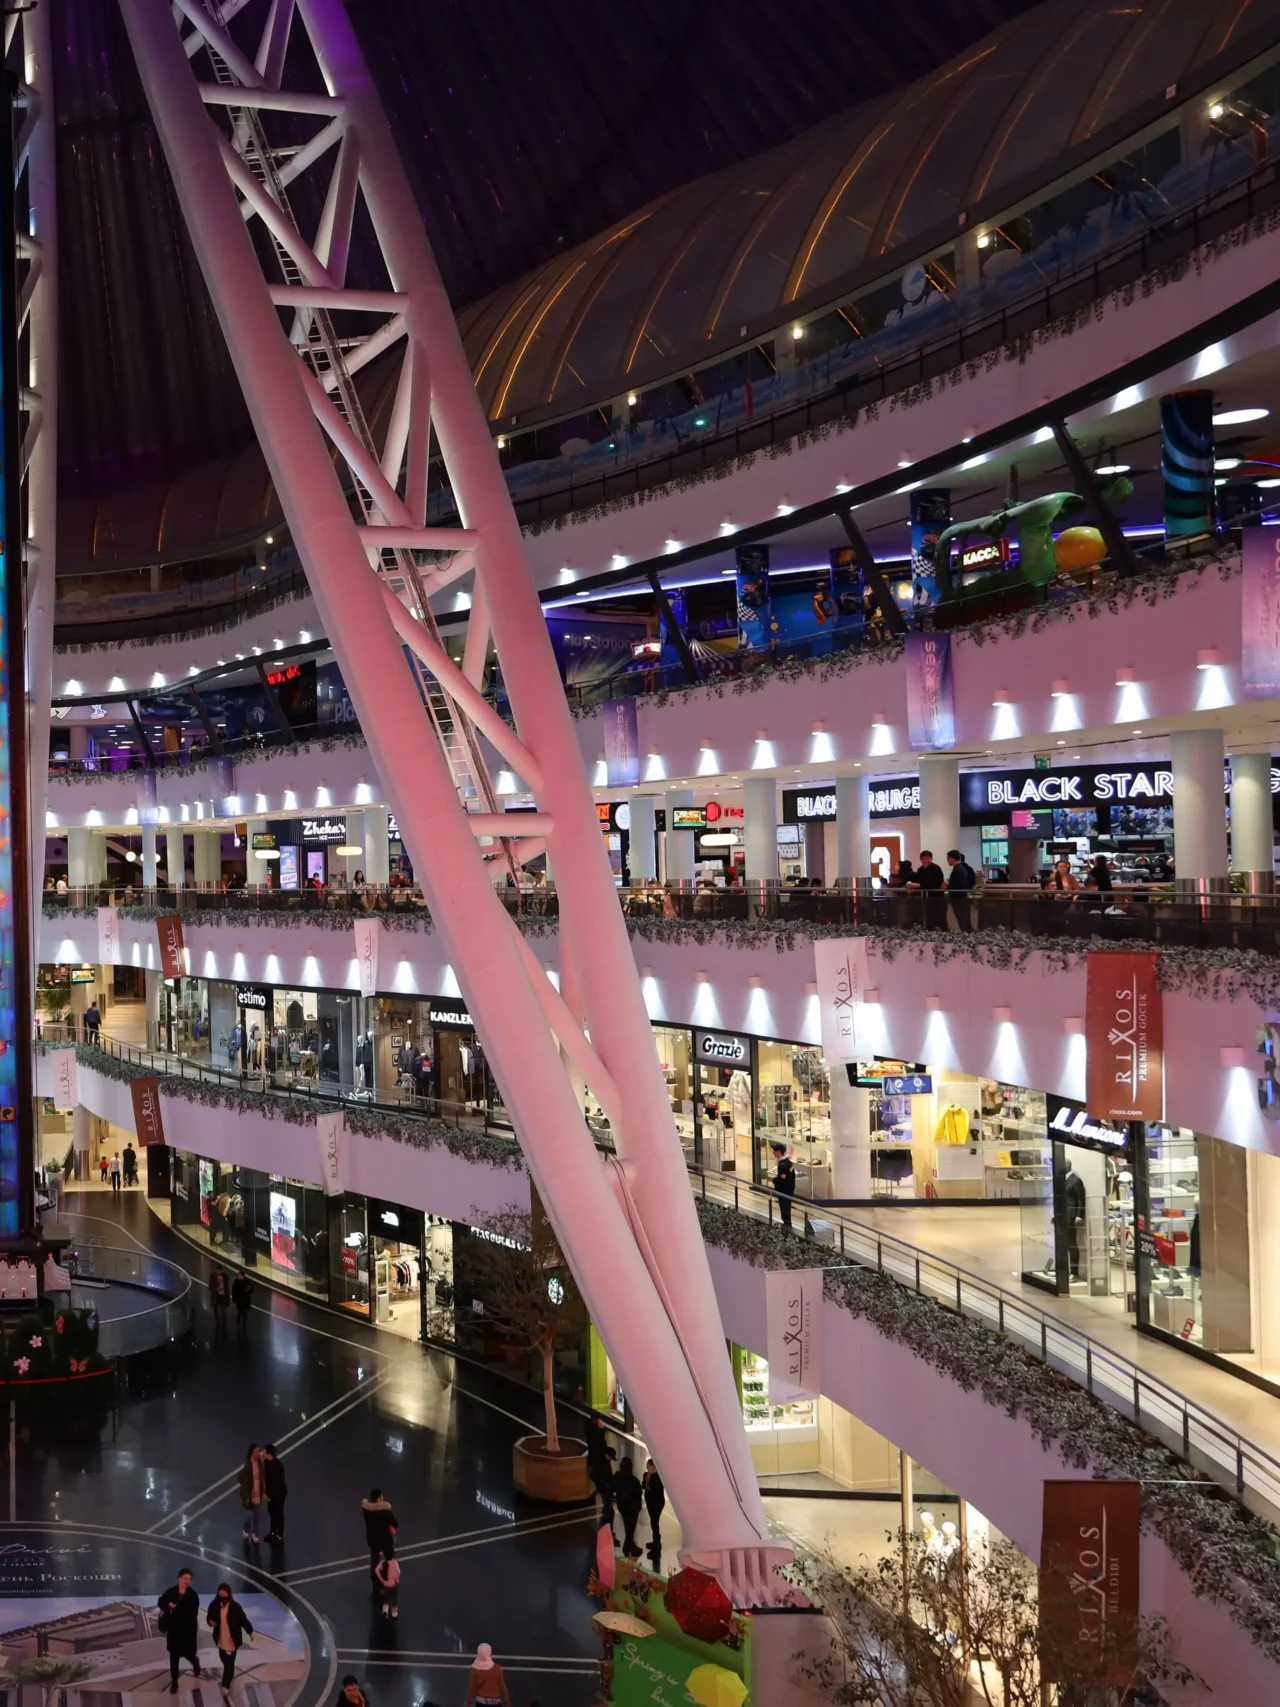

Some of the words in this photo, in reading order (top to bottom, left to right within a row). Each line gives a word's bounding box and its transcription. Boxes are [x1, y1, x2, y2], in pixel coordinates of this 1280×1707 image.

[963, 545, 1000, 567] КАССА
[878, 786, 920, 812] BURGE
[988, 775, 1082, 805] BLACK
[1093, 771, 1174, 799] STAR
[303, 820, 346, 836] Zheka's
[167, 929, 178, 966] RIXOS
[238, 990, 266, 1006] estimo
[833, 967, 853, 1036] RIXOS
[430, 1011, 473, 1025] KANZLER
[1108, 989, 1136, 1083] RIXOS
[702, 1035, 745, 1059] Grazie
[1139, 1032, 1147, 1081] PREMIUM
[142, 1092, 154, 1131] RIXOS
[1109, 1108, 1143, 1116] rixos.com
[327, 1132, 338, 1178] RIXOS
[782, 1299, 802, 1375] RIXOS
[40, 1572, 122, 1582] Роскоши
[1069, 1526, 1106, 1642] RIXOS
[1109, 1557, 1119, 1613] BELDIBI
[623, 1642, 666, 1682] Spring
